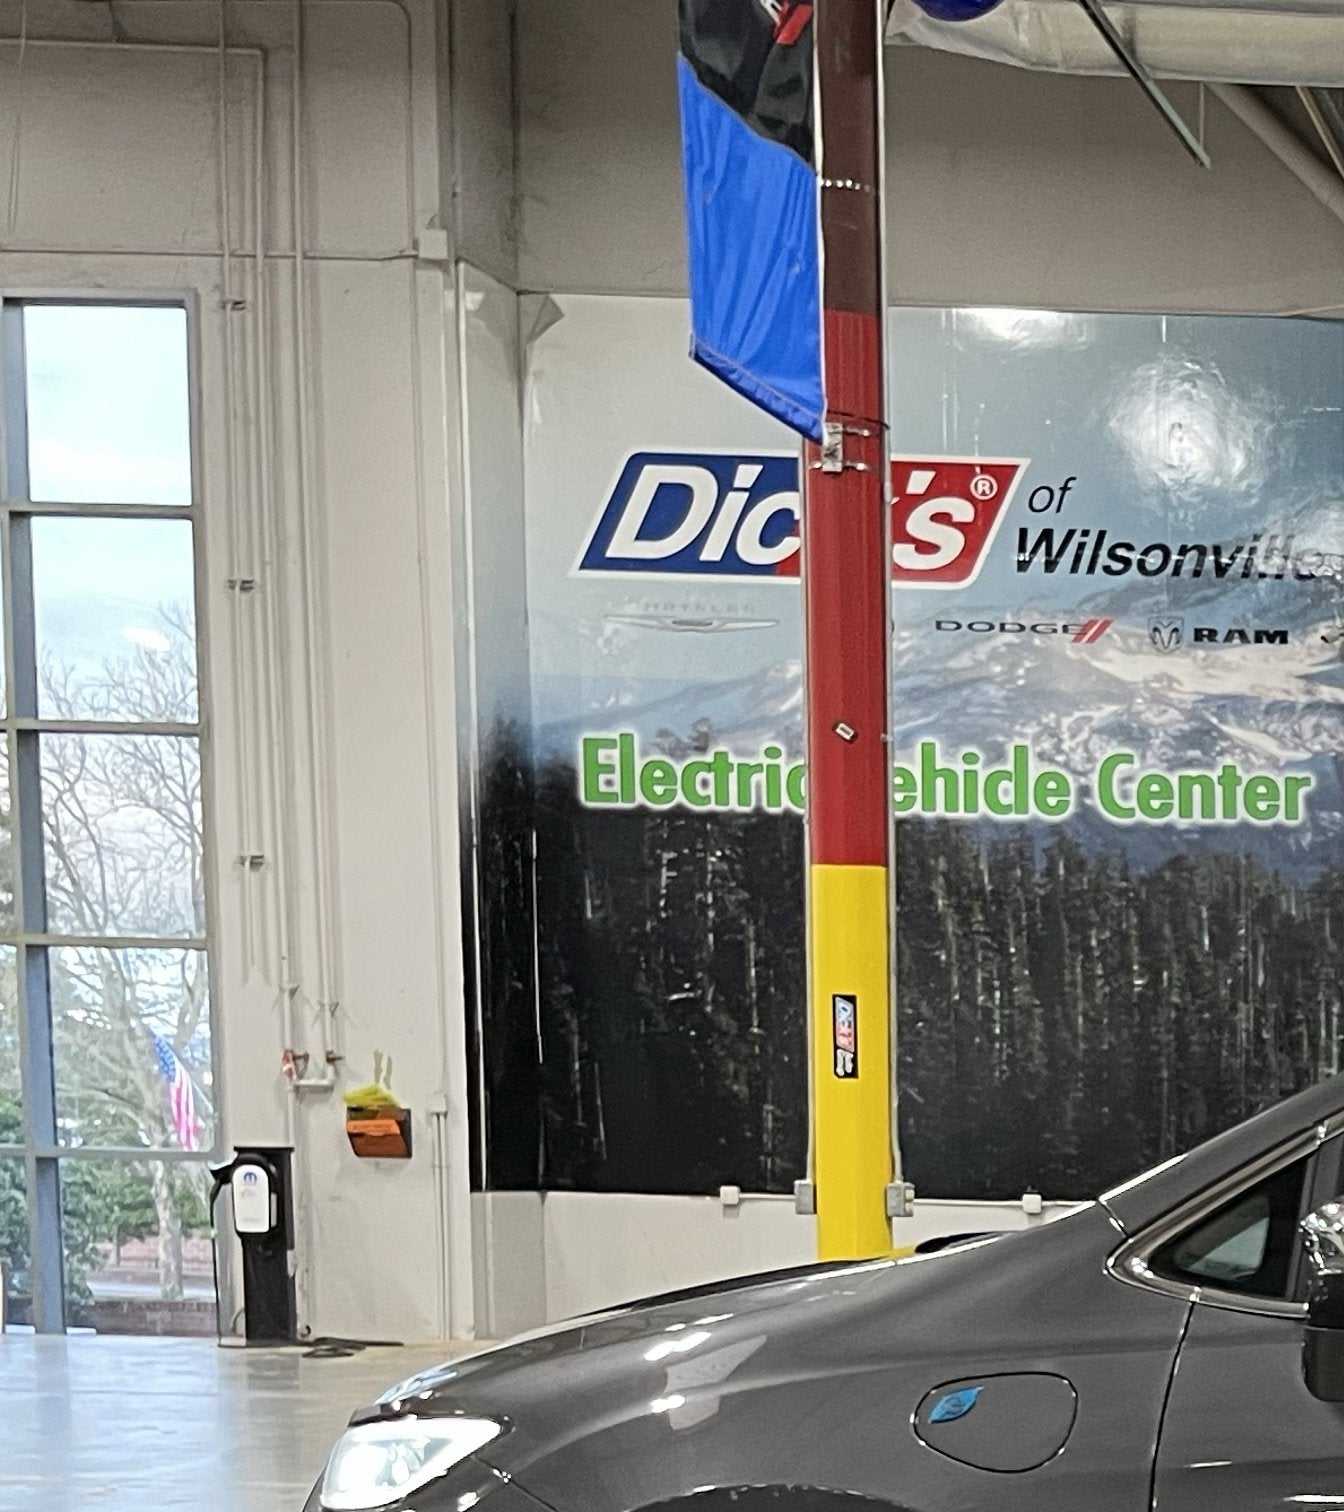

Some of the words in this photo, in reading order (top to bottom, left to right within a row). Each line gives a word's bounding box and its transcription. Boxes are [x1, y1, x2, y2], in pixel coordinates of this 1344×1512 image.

[1028, 476, 1076, 513] of
[605, 464, 975, 571] Dic's
[935, 619, 1088, 635] DODGE
[1193, 627, 1289, 645] RAM
[894, 742, 1071, 816] ehicle
[1099, 752, 1312, 820] Center
